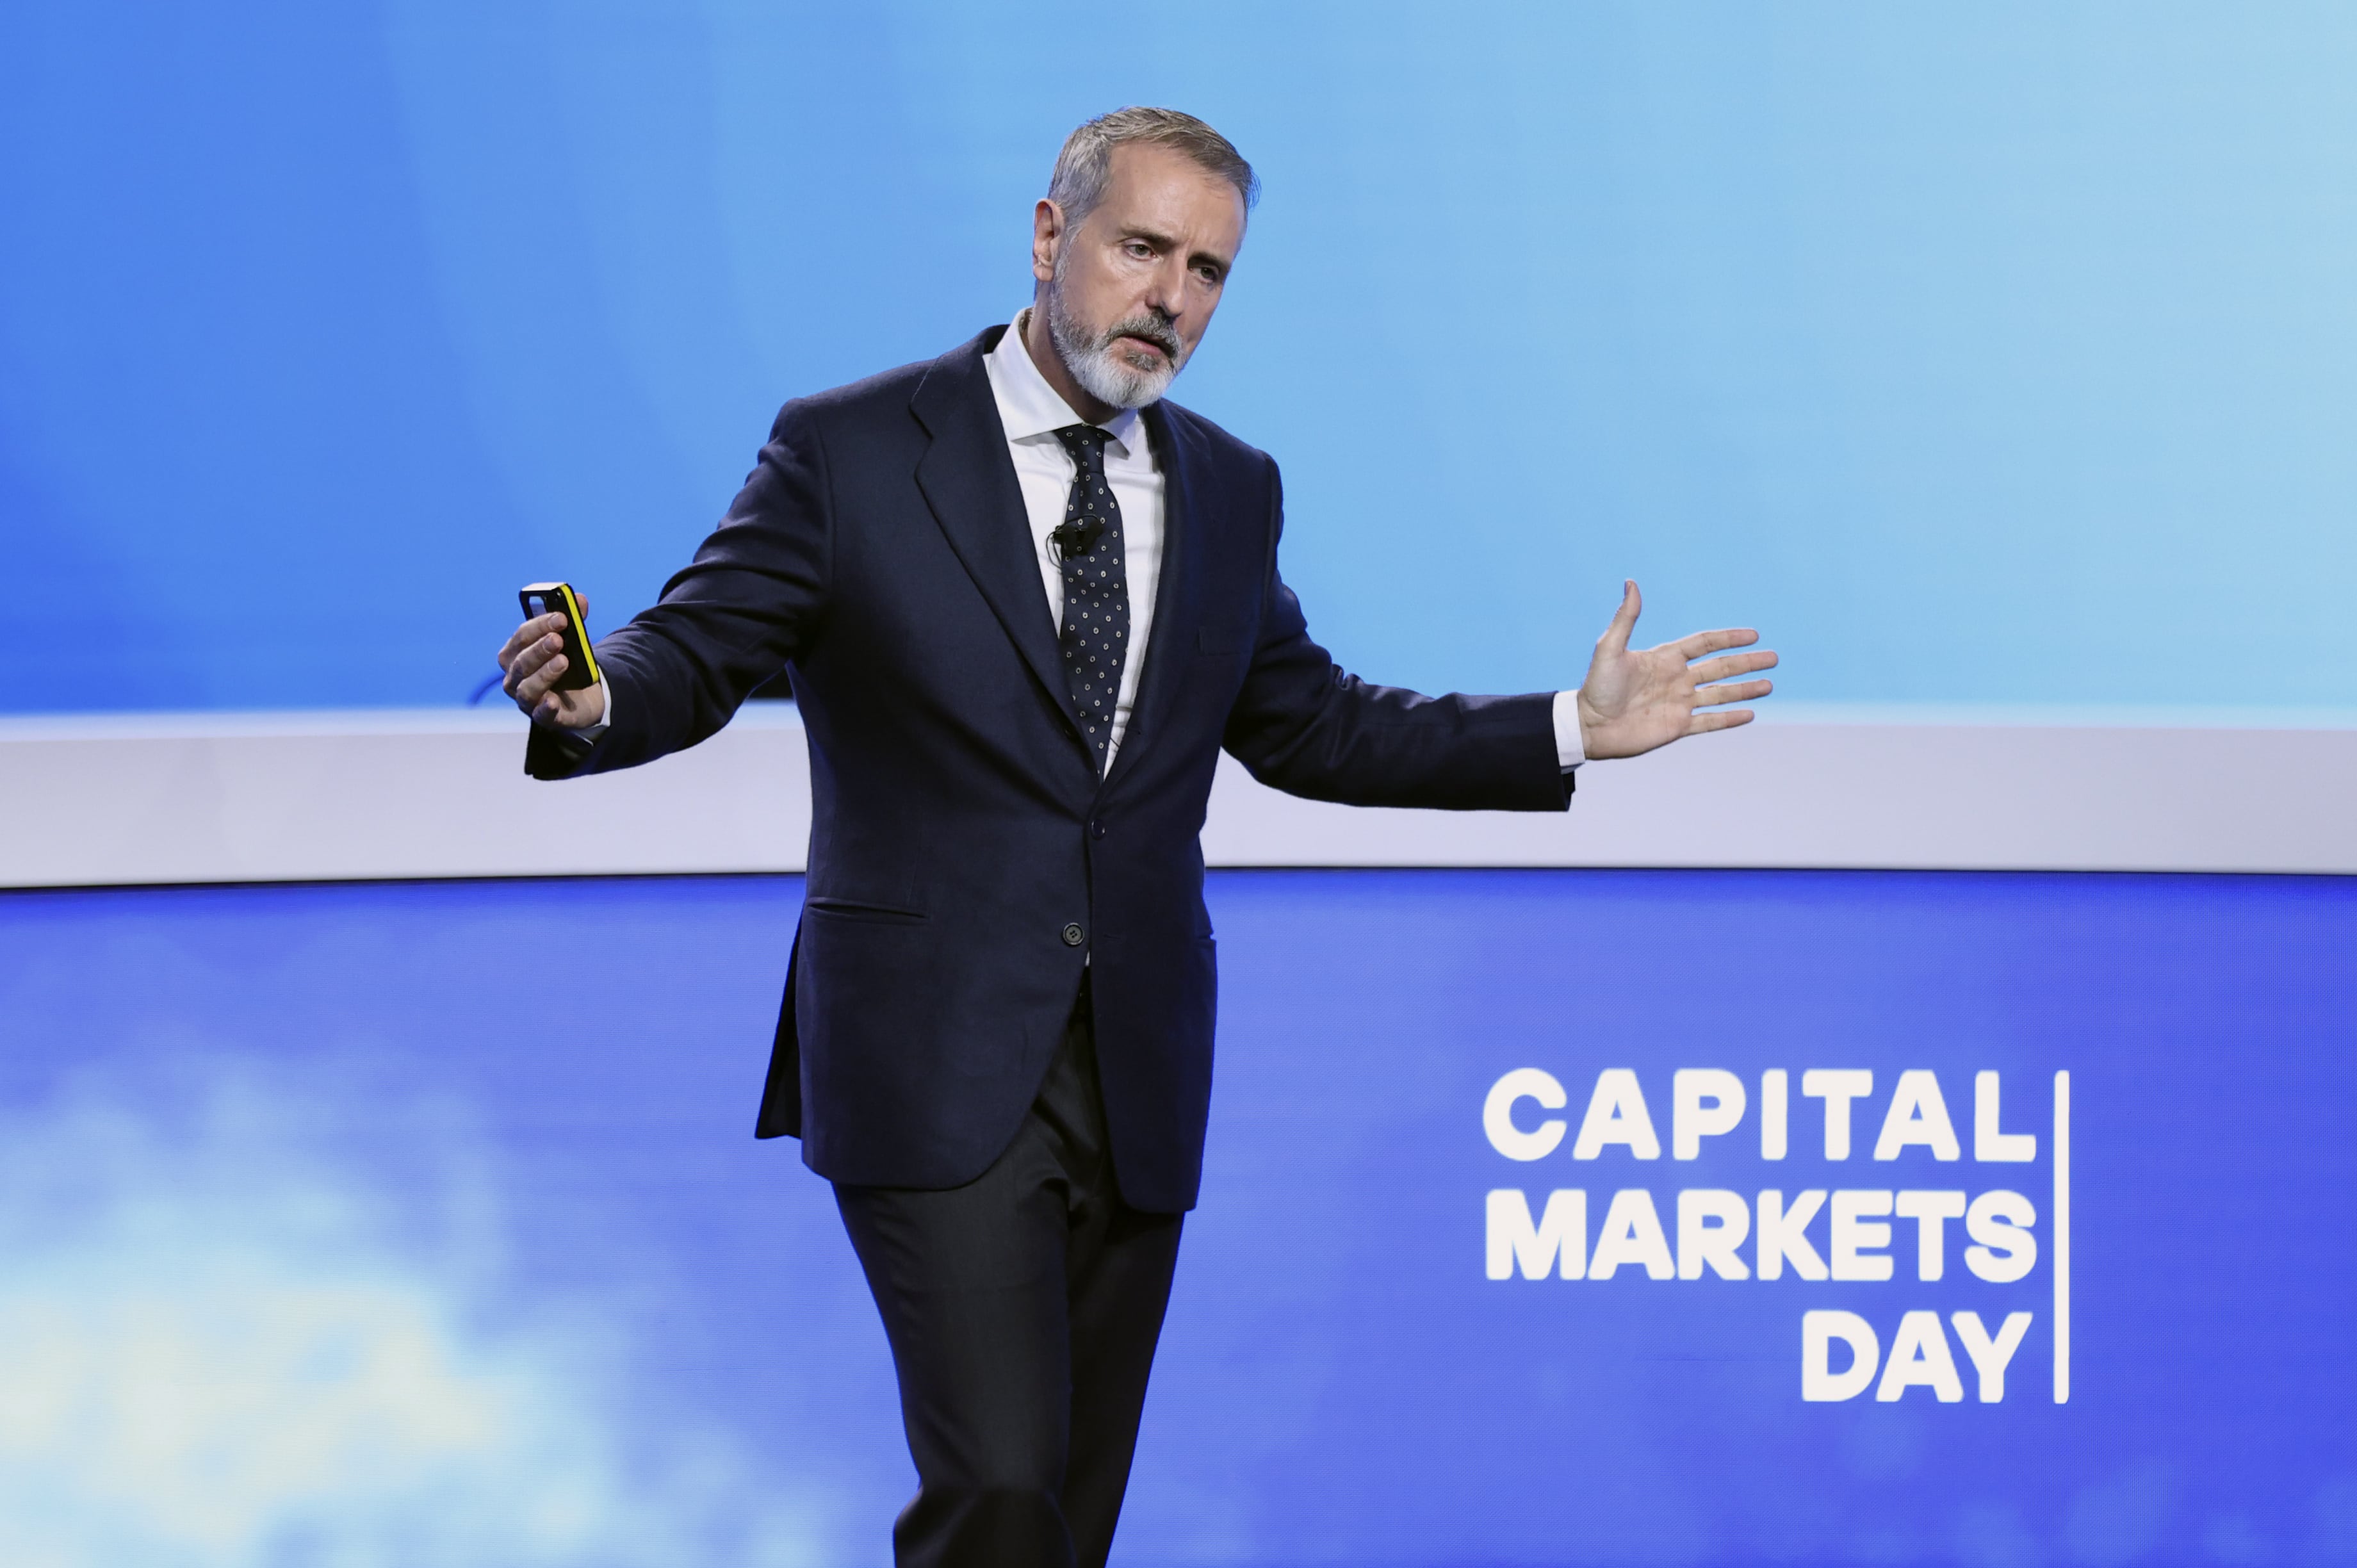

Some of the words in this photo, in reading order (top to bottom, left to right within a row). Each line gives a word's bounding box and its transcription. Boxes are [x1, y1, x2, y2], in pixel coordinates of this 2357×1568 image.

[1483, 1067, 2037, 1162] CAPITAL
[1485, 1189, 2037, 1283] MARKETS
[1802, 1310, 2034, 1403] DAY
